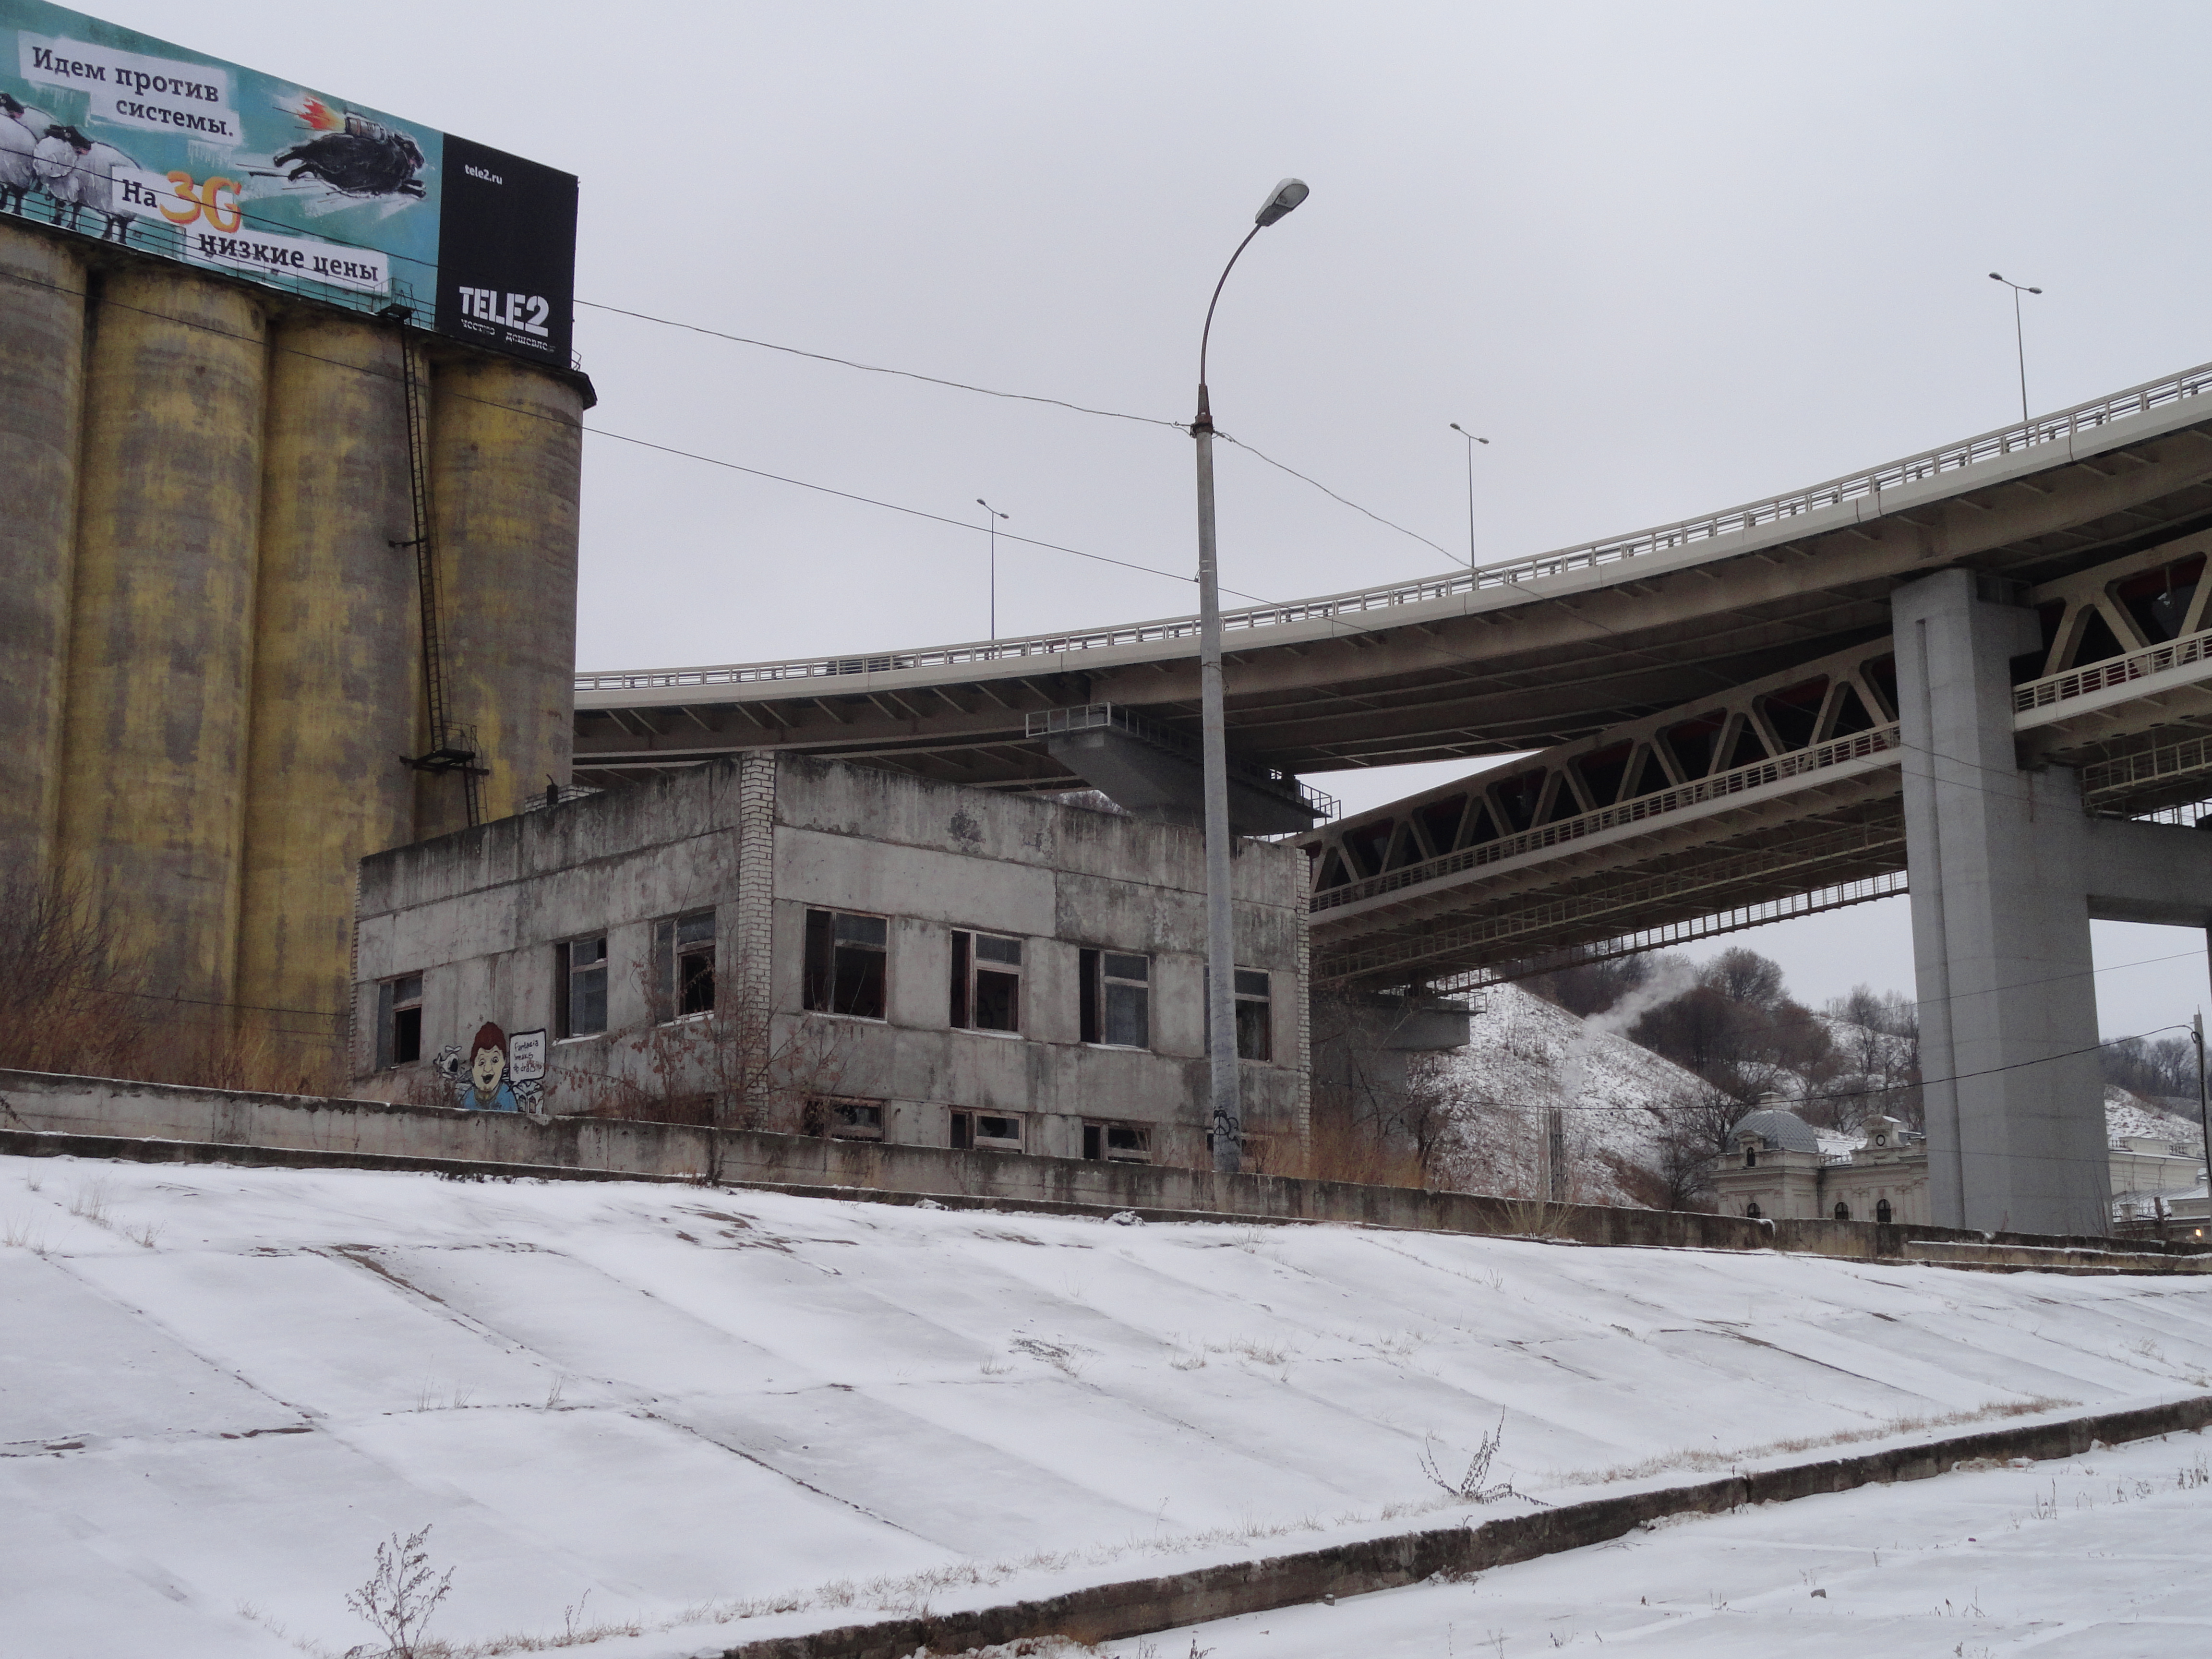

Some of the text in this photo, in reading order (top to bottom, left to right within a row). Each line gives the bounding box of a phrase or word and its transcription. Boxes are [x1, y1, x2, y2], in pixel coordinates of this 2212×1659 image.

[33, 47, 219, 102] Идем против
[117, 99, 234, 136] системы.
[465, 164, 502, 185] tele2.ru
[122, 171, 242, 233] На 3G
[198, 233, 379, 281] низкие цены
[459, 286, 549, 337] TELE2
